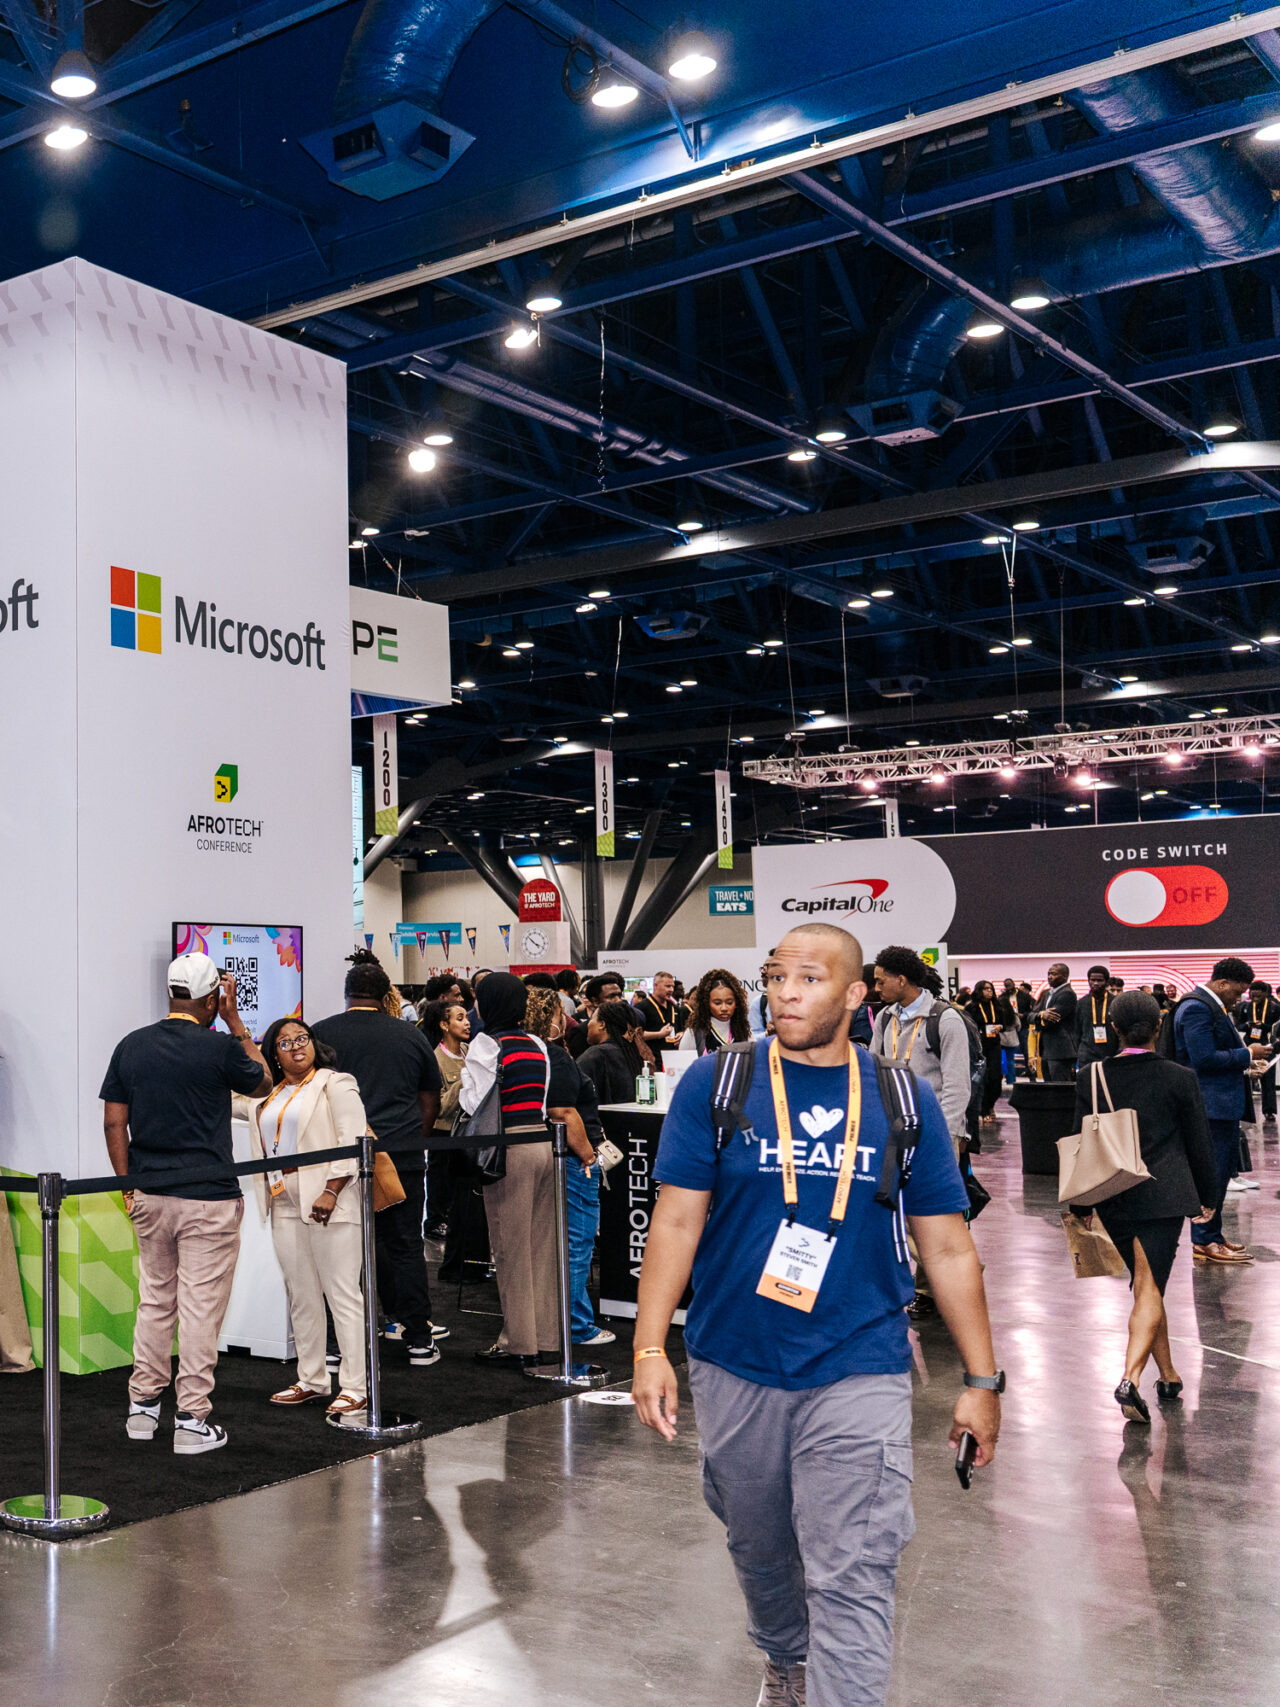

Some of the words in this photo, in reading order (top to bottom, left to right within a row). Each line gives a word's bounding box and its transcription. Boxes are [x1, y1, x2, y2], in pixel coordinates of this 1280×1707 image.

[175, 595, 326, 671] Microsoft
[382, 730, 391, 807] 1200
[601, 765, 609, 832] 1300
[187, 814, 262, 838] AFROTECH
[196, 838, 253, 854] CONFERENCE
[1101, 848, 1150, 862] CODE
[1156, 843, 1228, 859] SWITCH
[523, 892, 537, 903] THE
[538, 891, 556, 902] YARD
[1172, 886, 1218, 904] OFF
[716, 902, 748, 912] EATS
[232, 934, 261, 944] Microsoft
